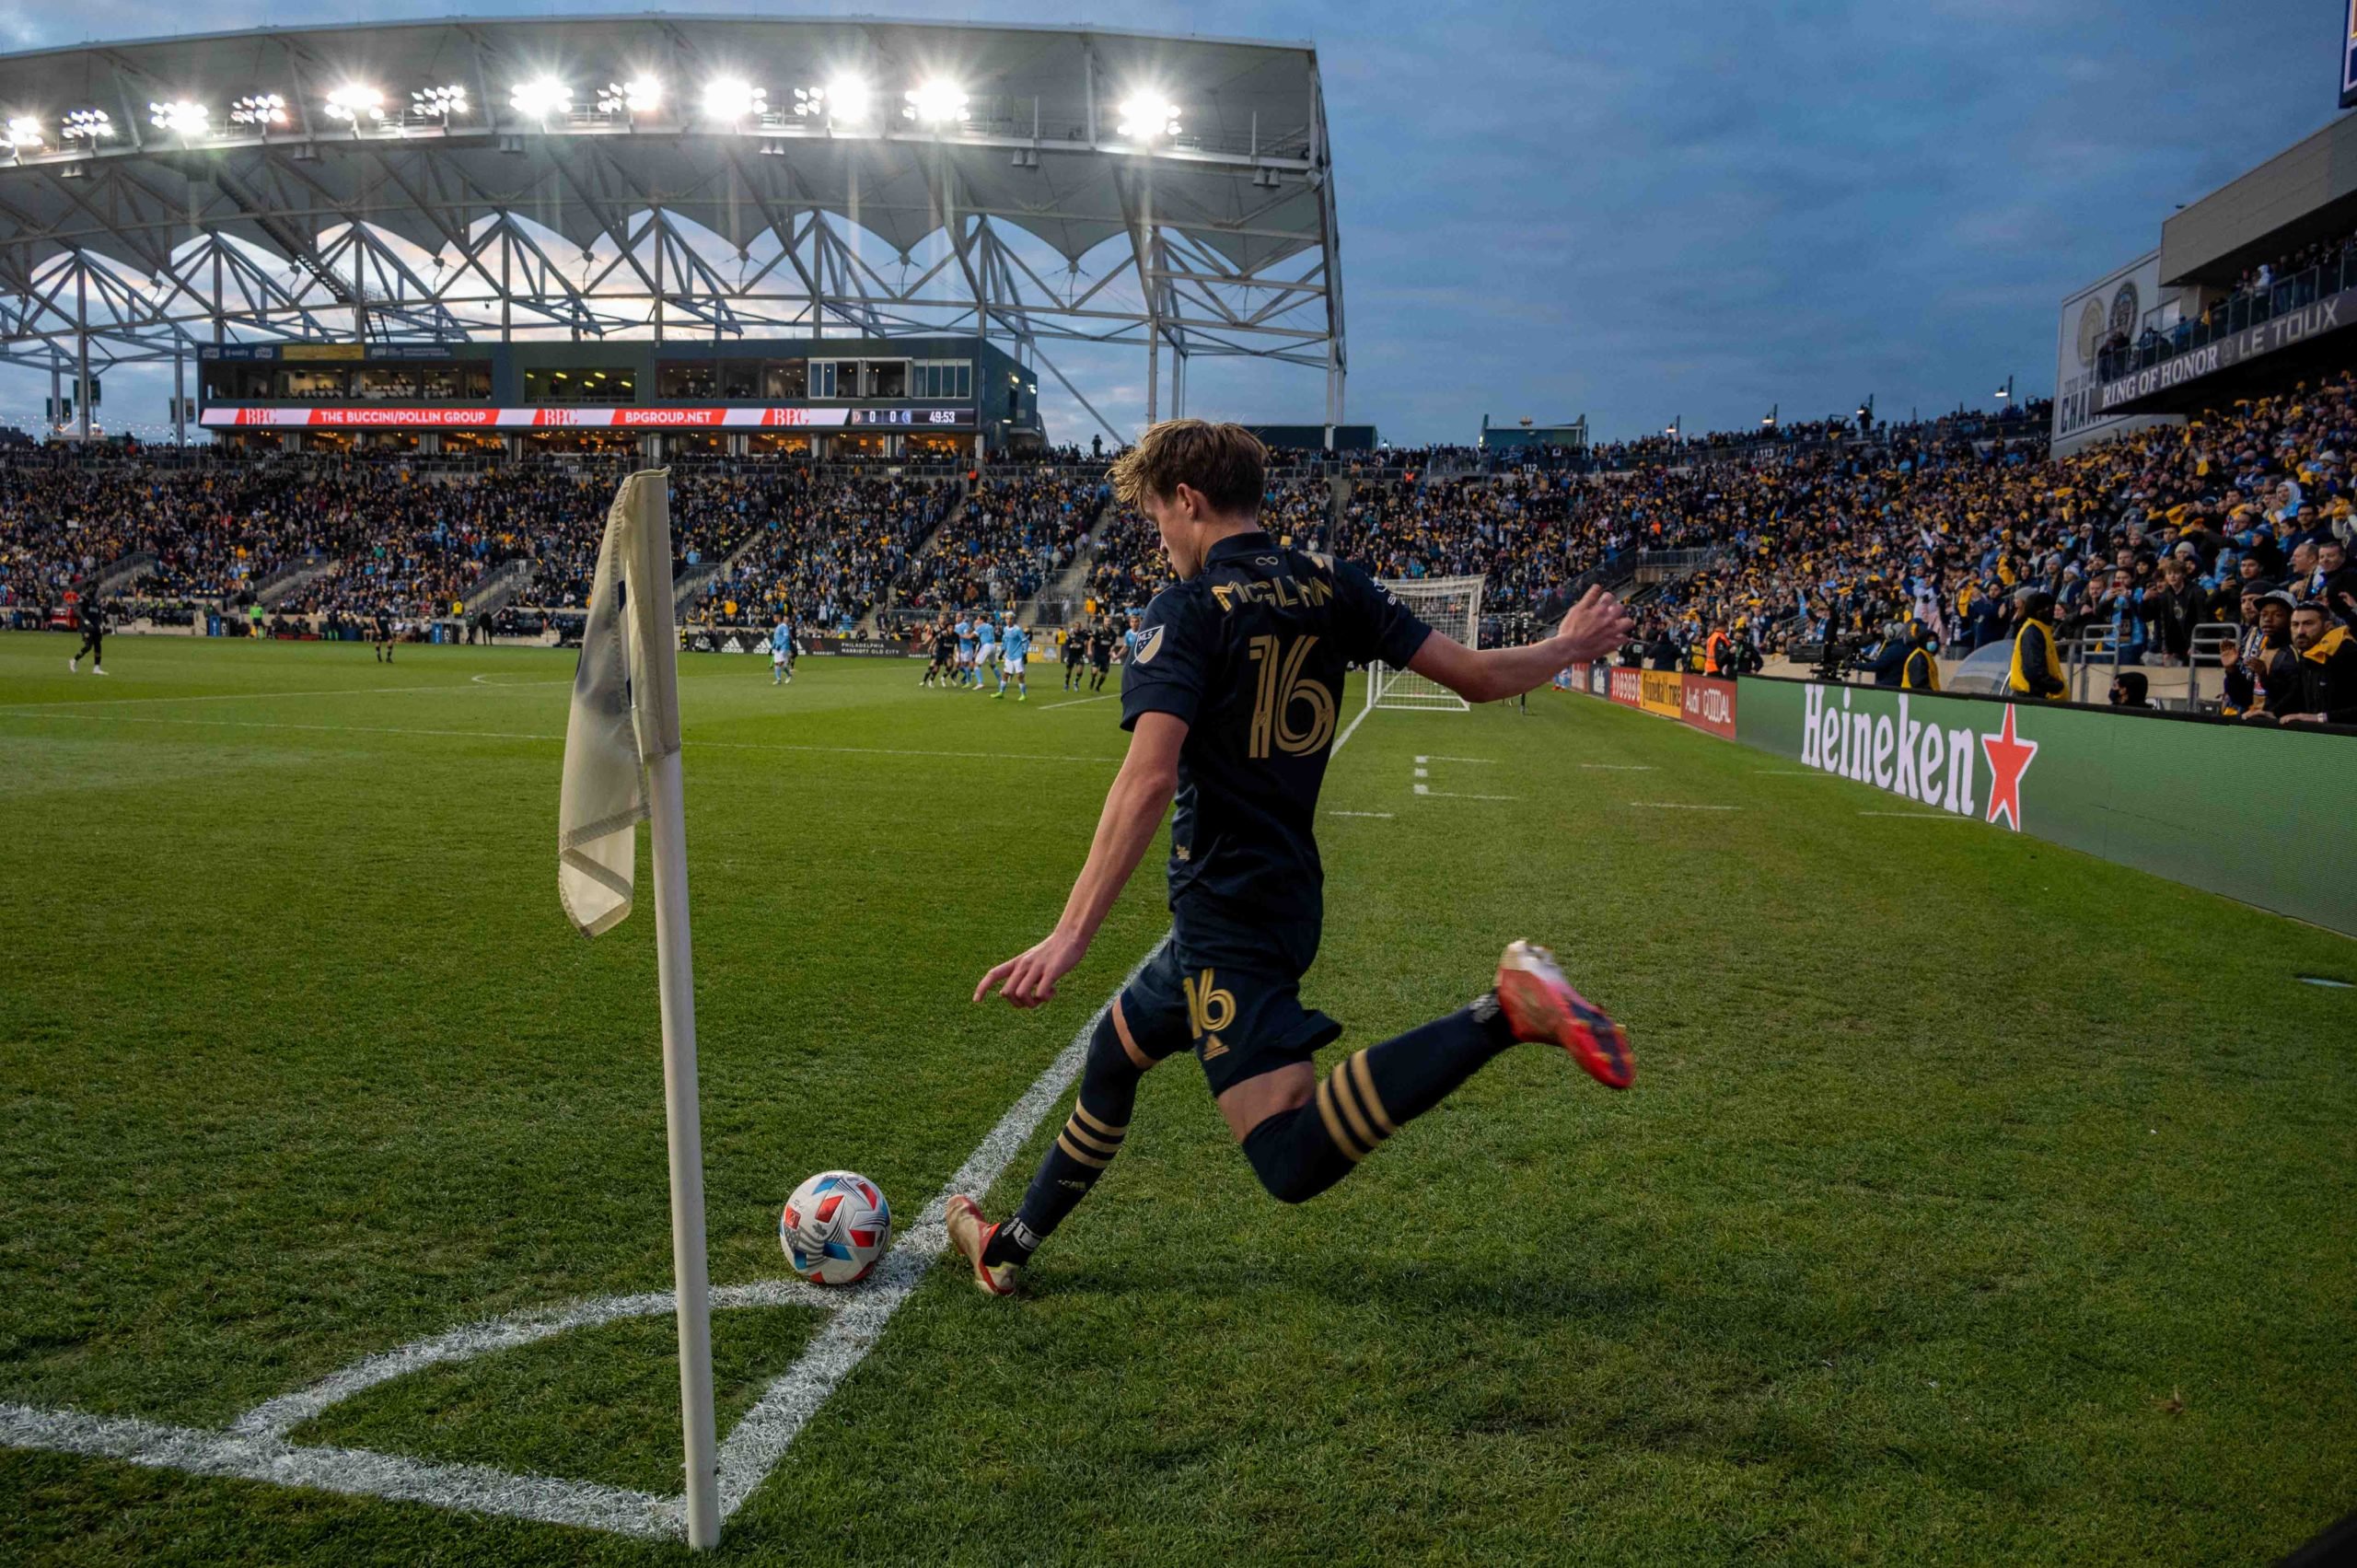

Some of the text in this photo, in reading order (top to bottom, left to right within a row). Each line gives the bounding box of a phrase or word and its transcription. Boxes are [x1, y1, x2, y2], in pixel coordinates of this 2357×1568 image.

[2102, 375, 2136, 408] RING
[2138, 369, 2159, 395] OF
[2160, 345, 2218, 388] HONOR
[2238, 331, 2264, 359] LE
[2271, 297, 2340, 343] TOUX
[320, 411, 486, 424] THE BUCCINI/POLLIN GROUP
[625, 411, 713, 424] BPGROUP.NET
[869, 411, 897, 424] 0 0
[929, 411, 956, 424] 49:53
[567, 465, 580, 473] 107
[1523, 463, 1538, 472] 112
[1138, 631, 1154, 643] MLS
[1248, 634, 1336, 759] 16
[1685, 686, 1700, 714] Audi
[1801, 683, 1975, 817] Heineken
[1182, 968, 1237, 1040] 16
